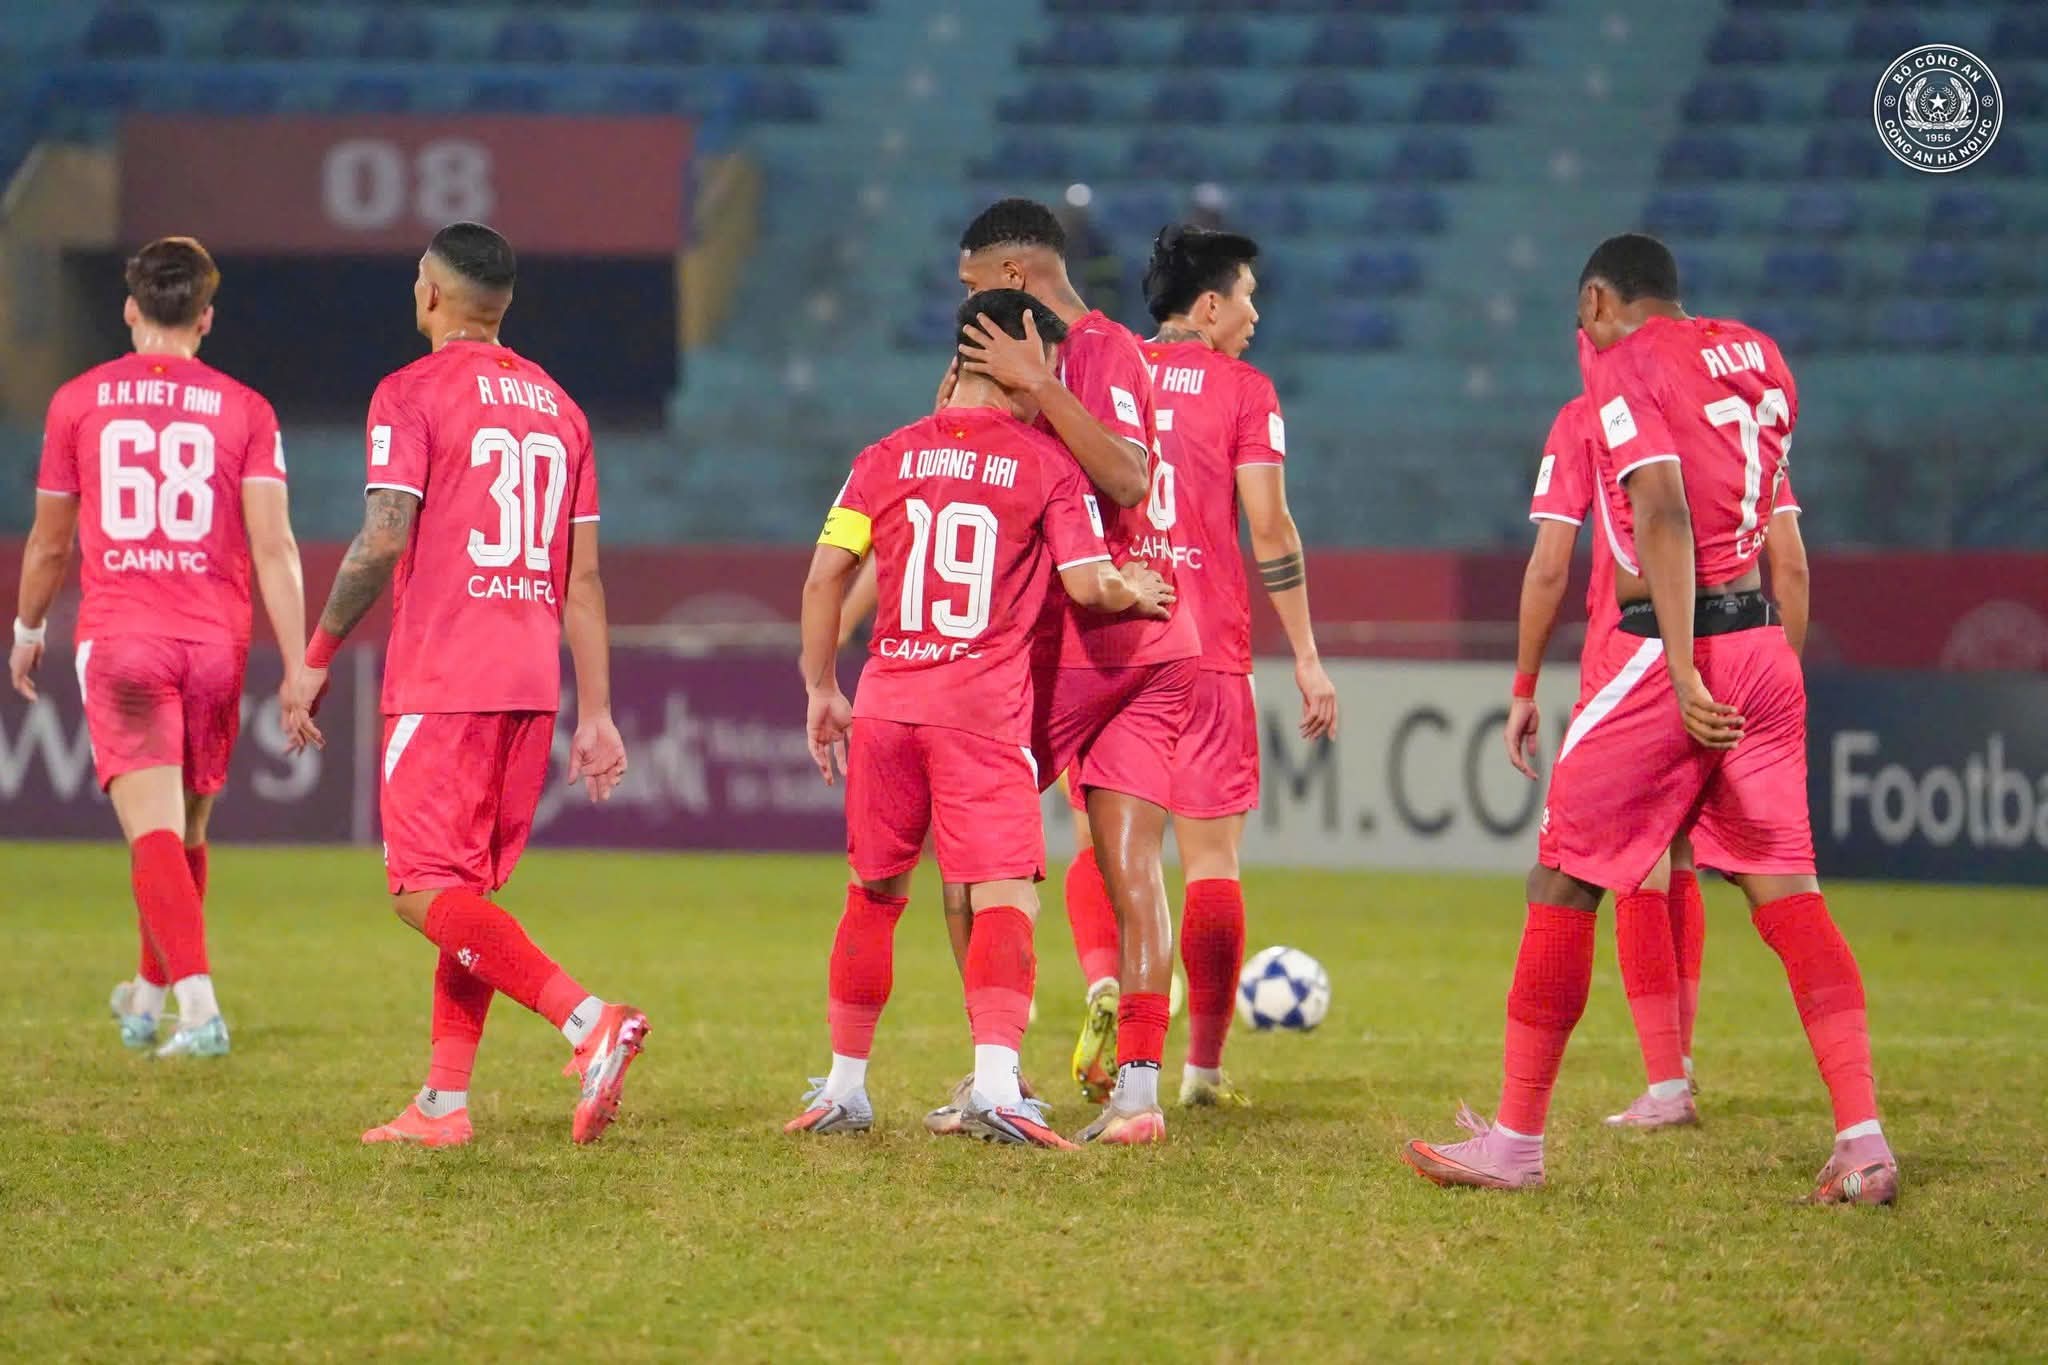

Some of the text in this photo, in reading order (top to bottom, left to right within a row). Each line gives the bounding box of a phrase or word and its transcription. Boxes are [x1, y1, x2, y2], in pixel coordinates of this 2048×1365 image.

[321, 139, 493, 232] 08
[499, 377, 559, 417] ALVES
[1162, 366, 1205, 395] HAU
[182, 385, 222, 416] ANH
[101, 419, 216, 542] 68
[981, 454, 1019, 488] HAI
[466, 427, 568, 572] 30
[103, 549, 208, 573] CAHN FC
[900, 498, 999, 639] 19
[1171, 546, 1203, 570] FC
[879, 637, 947, 662] CAHN
